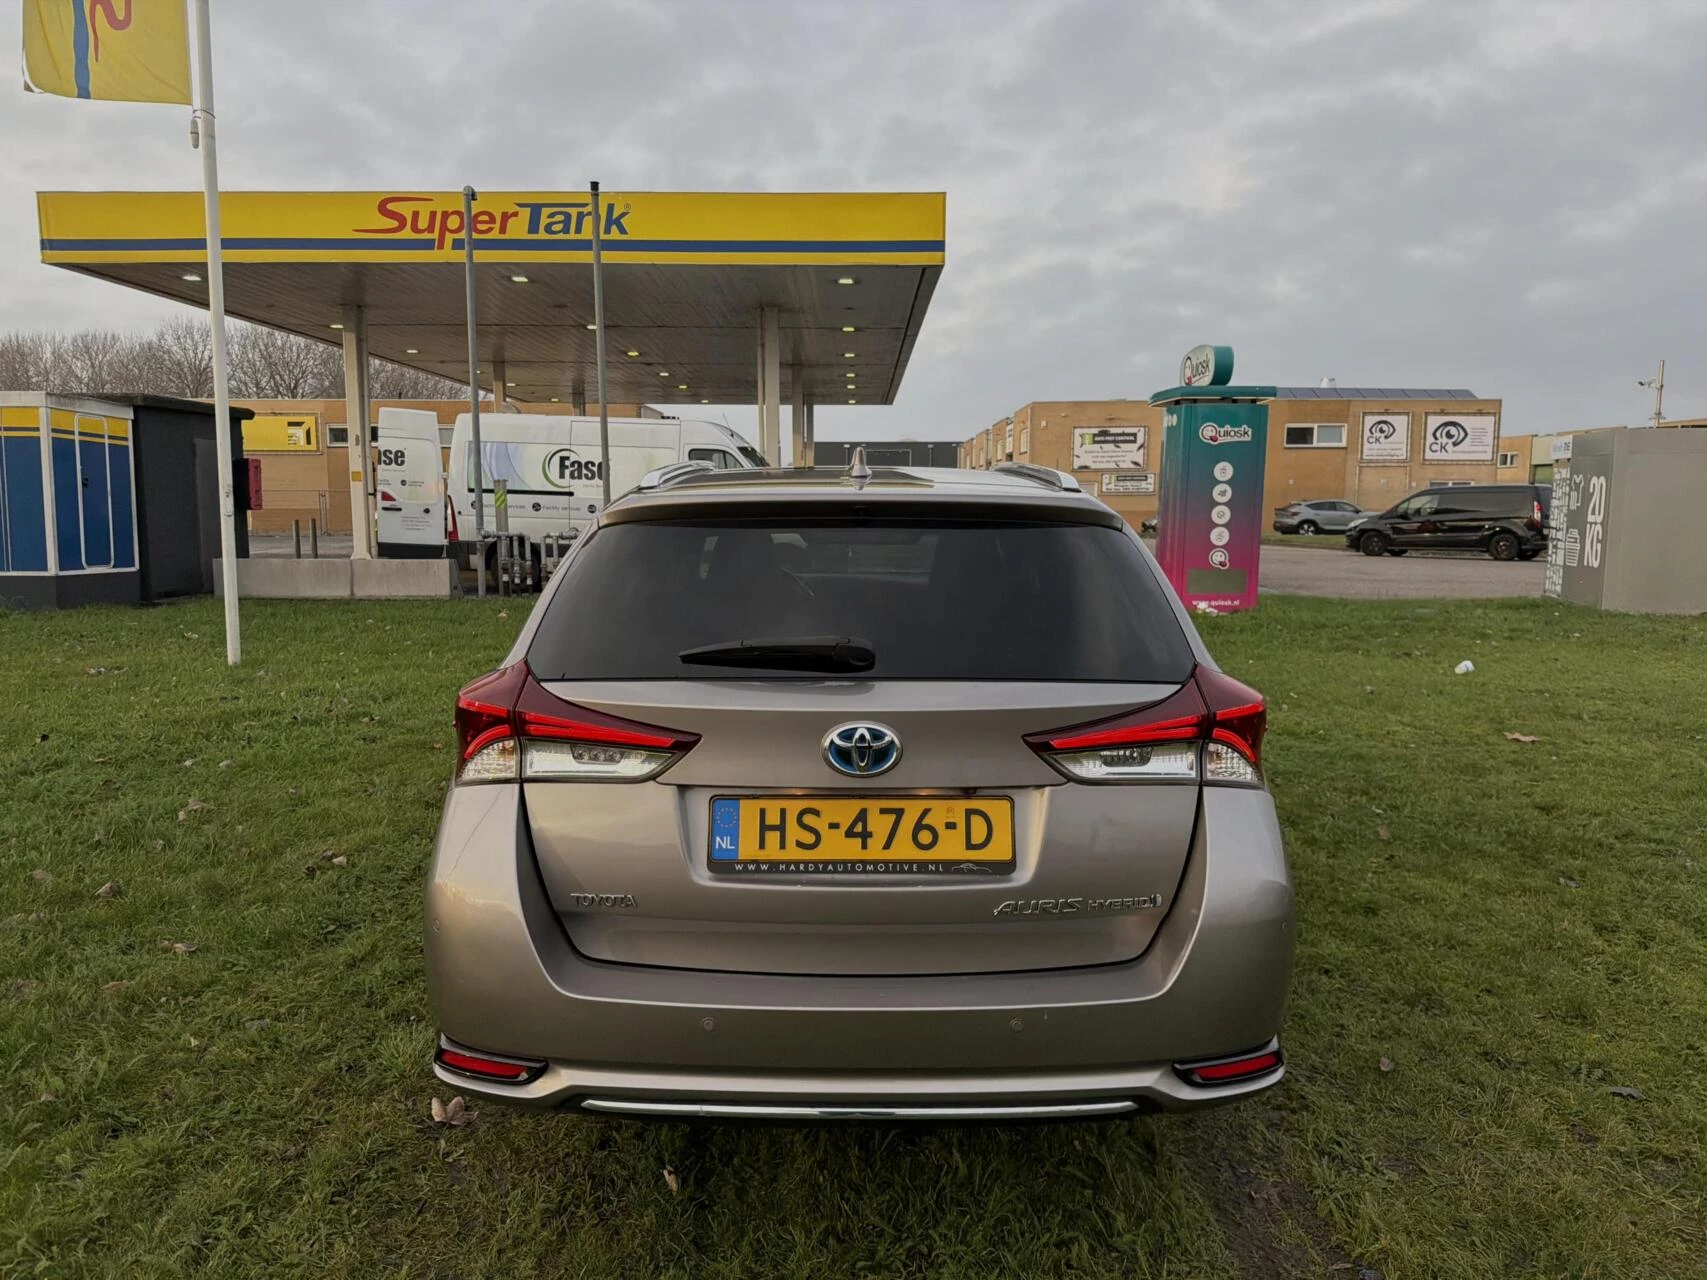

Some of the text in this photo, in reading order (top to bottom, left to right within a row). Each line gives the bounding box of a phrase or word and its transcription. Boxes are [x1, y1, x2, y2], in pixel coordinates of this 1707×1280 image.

[1367, 435, 1381, 445] CK
[1429, 442, 1449, 453] CK
[1588, 476, 1606, 522] 20
[1584, 524, 1602, 568] KG
[758, 807, 993, 851] HS-476-D
[715, 836, 736, 849] NL
[734, 864, 944, 873] WWW.HARDYAUTOMOTIVE.NL
[569, 893, 639, 909] TOYOTA
[993, 896, 1152, 916] AURIS HYBRID
